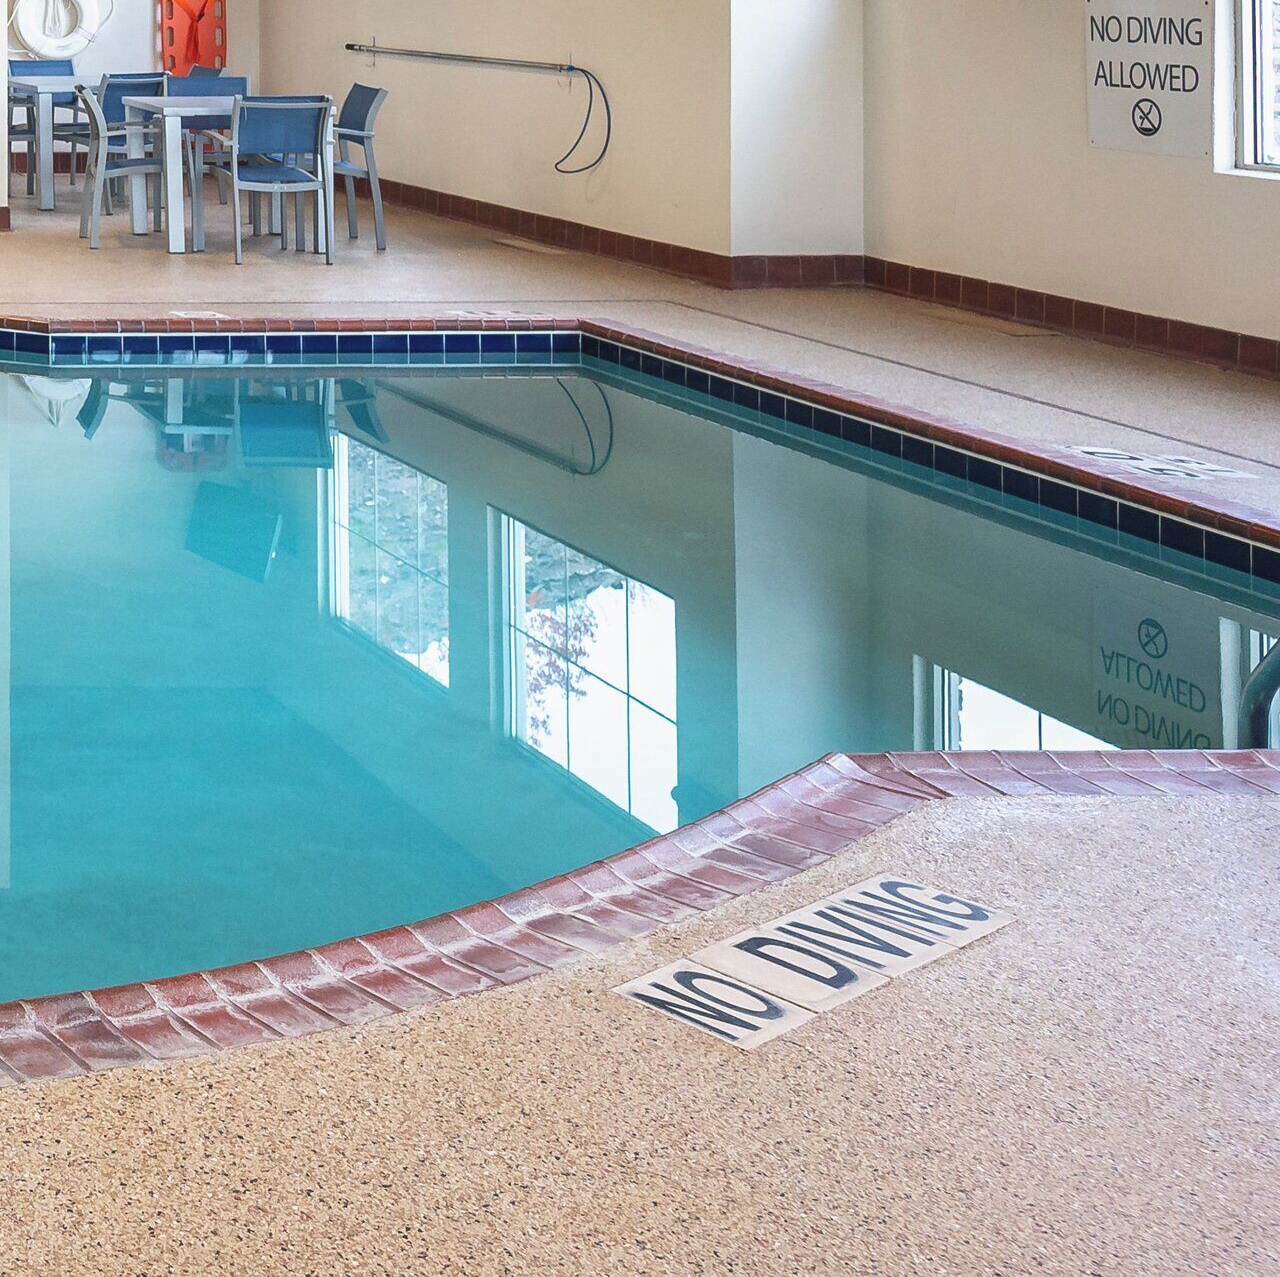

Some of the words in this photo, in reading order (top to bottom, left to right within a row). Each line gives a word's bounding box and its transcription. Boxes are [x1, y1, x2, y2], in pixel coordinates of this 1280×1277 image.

[1090, 15, 1122, 43] NO
[1127, 16, 1203, 46] DIVING
[1094, 60, 1200, 93] ALLOWED
[629, 969, 788, 1042] NO
[733, 879, 996, 990] DIVING
